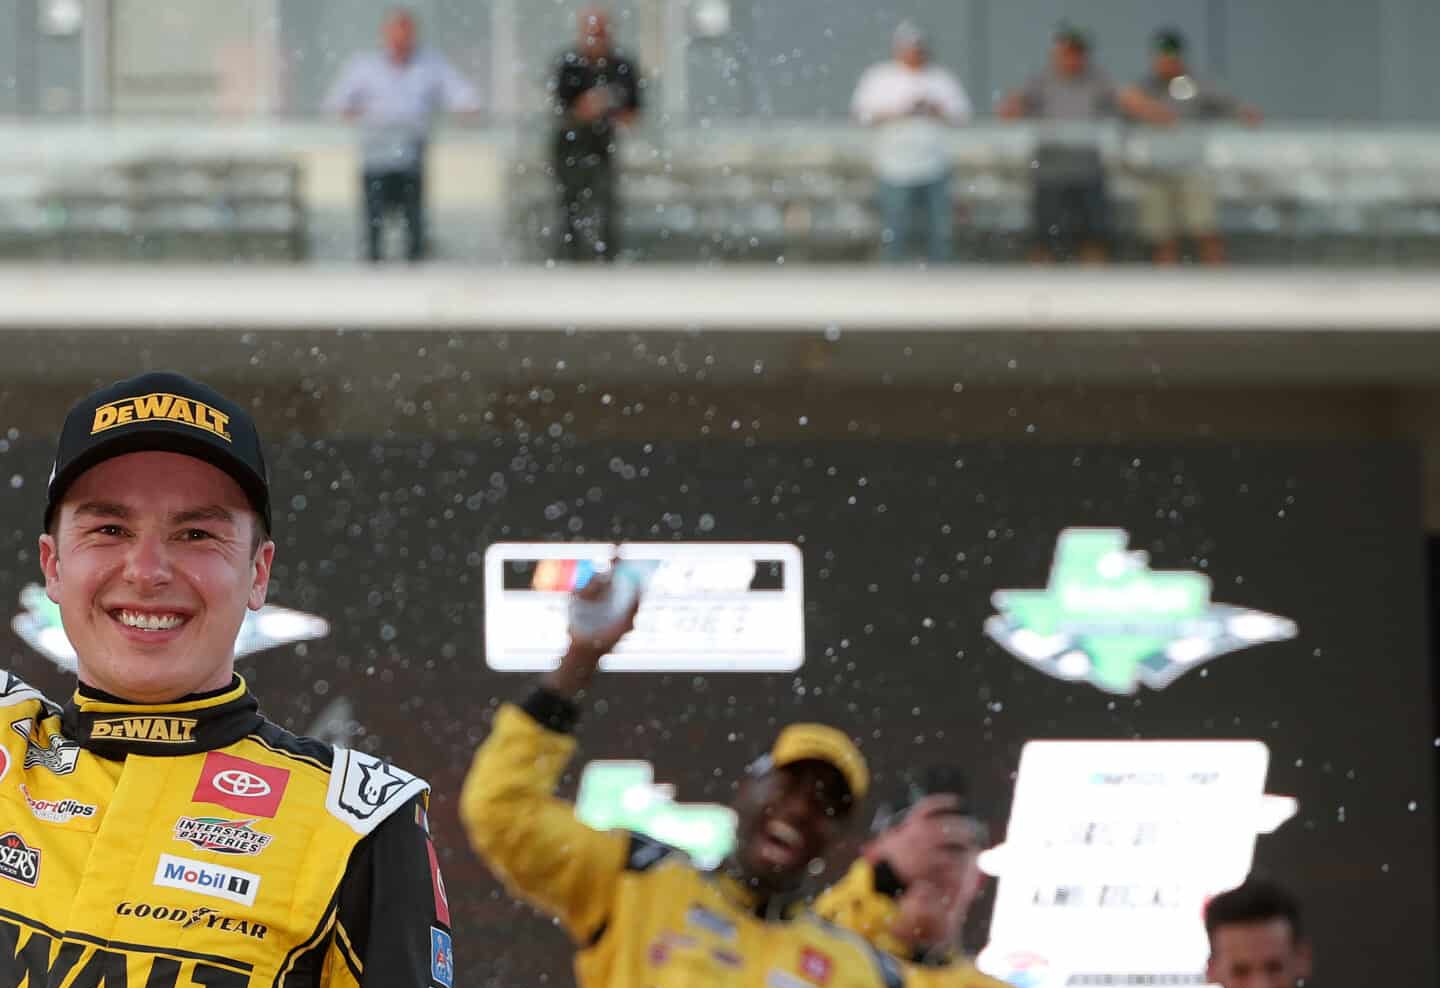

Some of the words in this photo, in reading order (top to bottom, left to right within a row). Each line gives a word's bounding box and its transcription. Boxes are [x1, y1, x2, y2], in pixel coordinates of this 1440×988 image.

[92, 395, 229, 435] DeWALT
[91, 718, 197, 742] DeWALT
[178, 819, 269, 844] INTERSTATE
[179, 831, 259, 853] BATTERIES
[163, 862, 226, 889] Mobil
